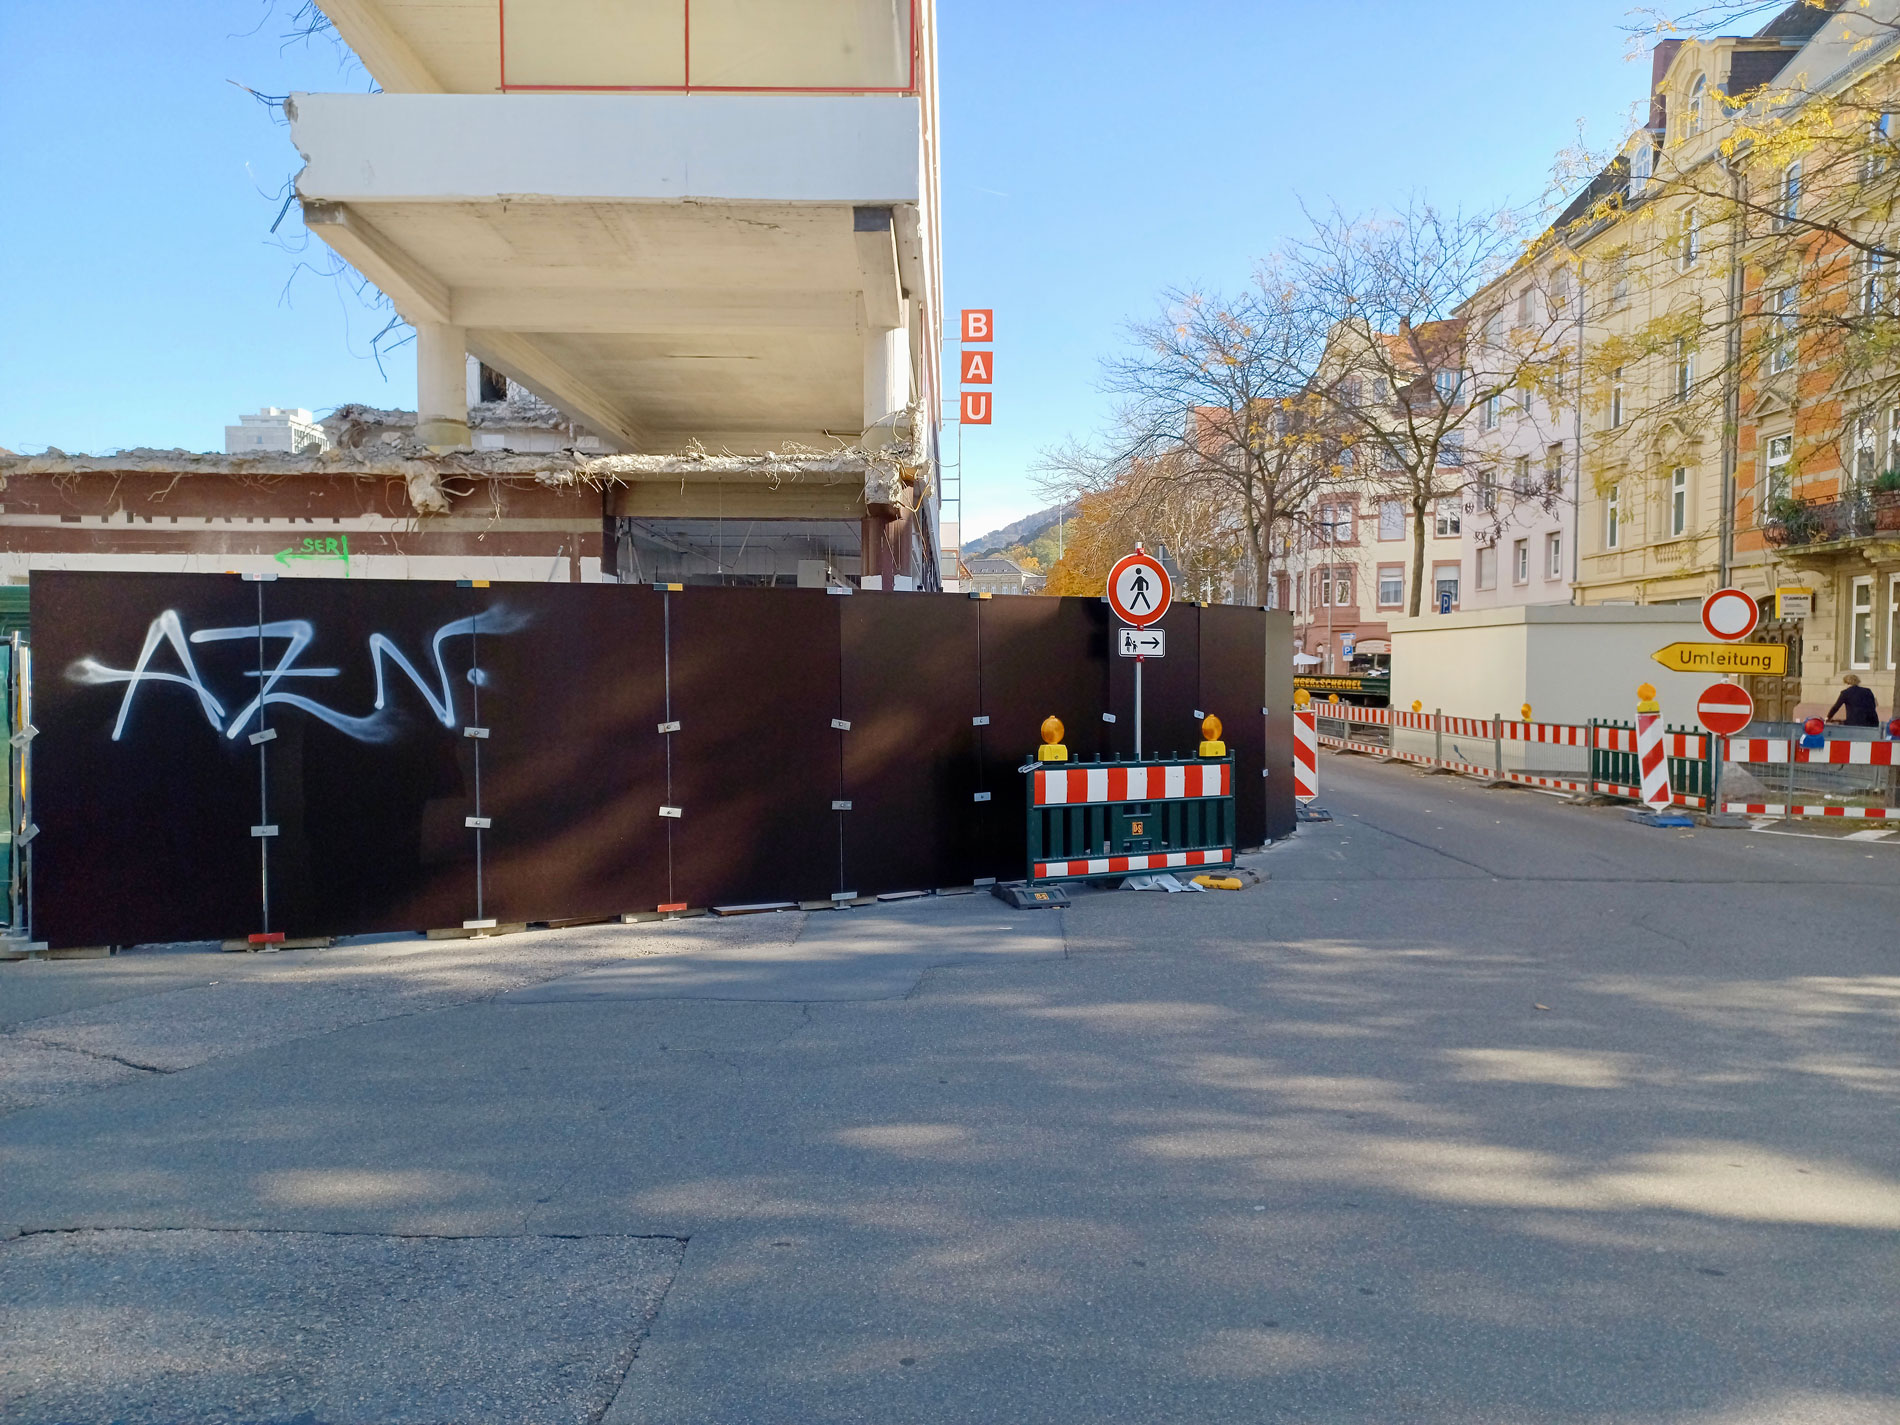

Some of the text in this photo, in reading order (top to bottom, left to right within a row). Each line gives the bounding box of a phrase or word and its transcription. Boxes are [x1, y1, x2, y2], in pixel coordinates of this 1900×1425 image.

[966, 312, 988, 420] BAU
[300, 537, 340, 556] SER
[1680, 650, 1772, 670] Umleitung
